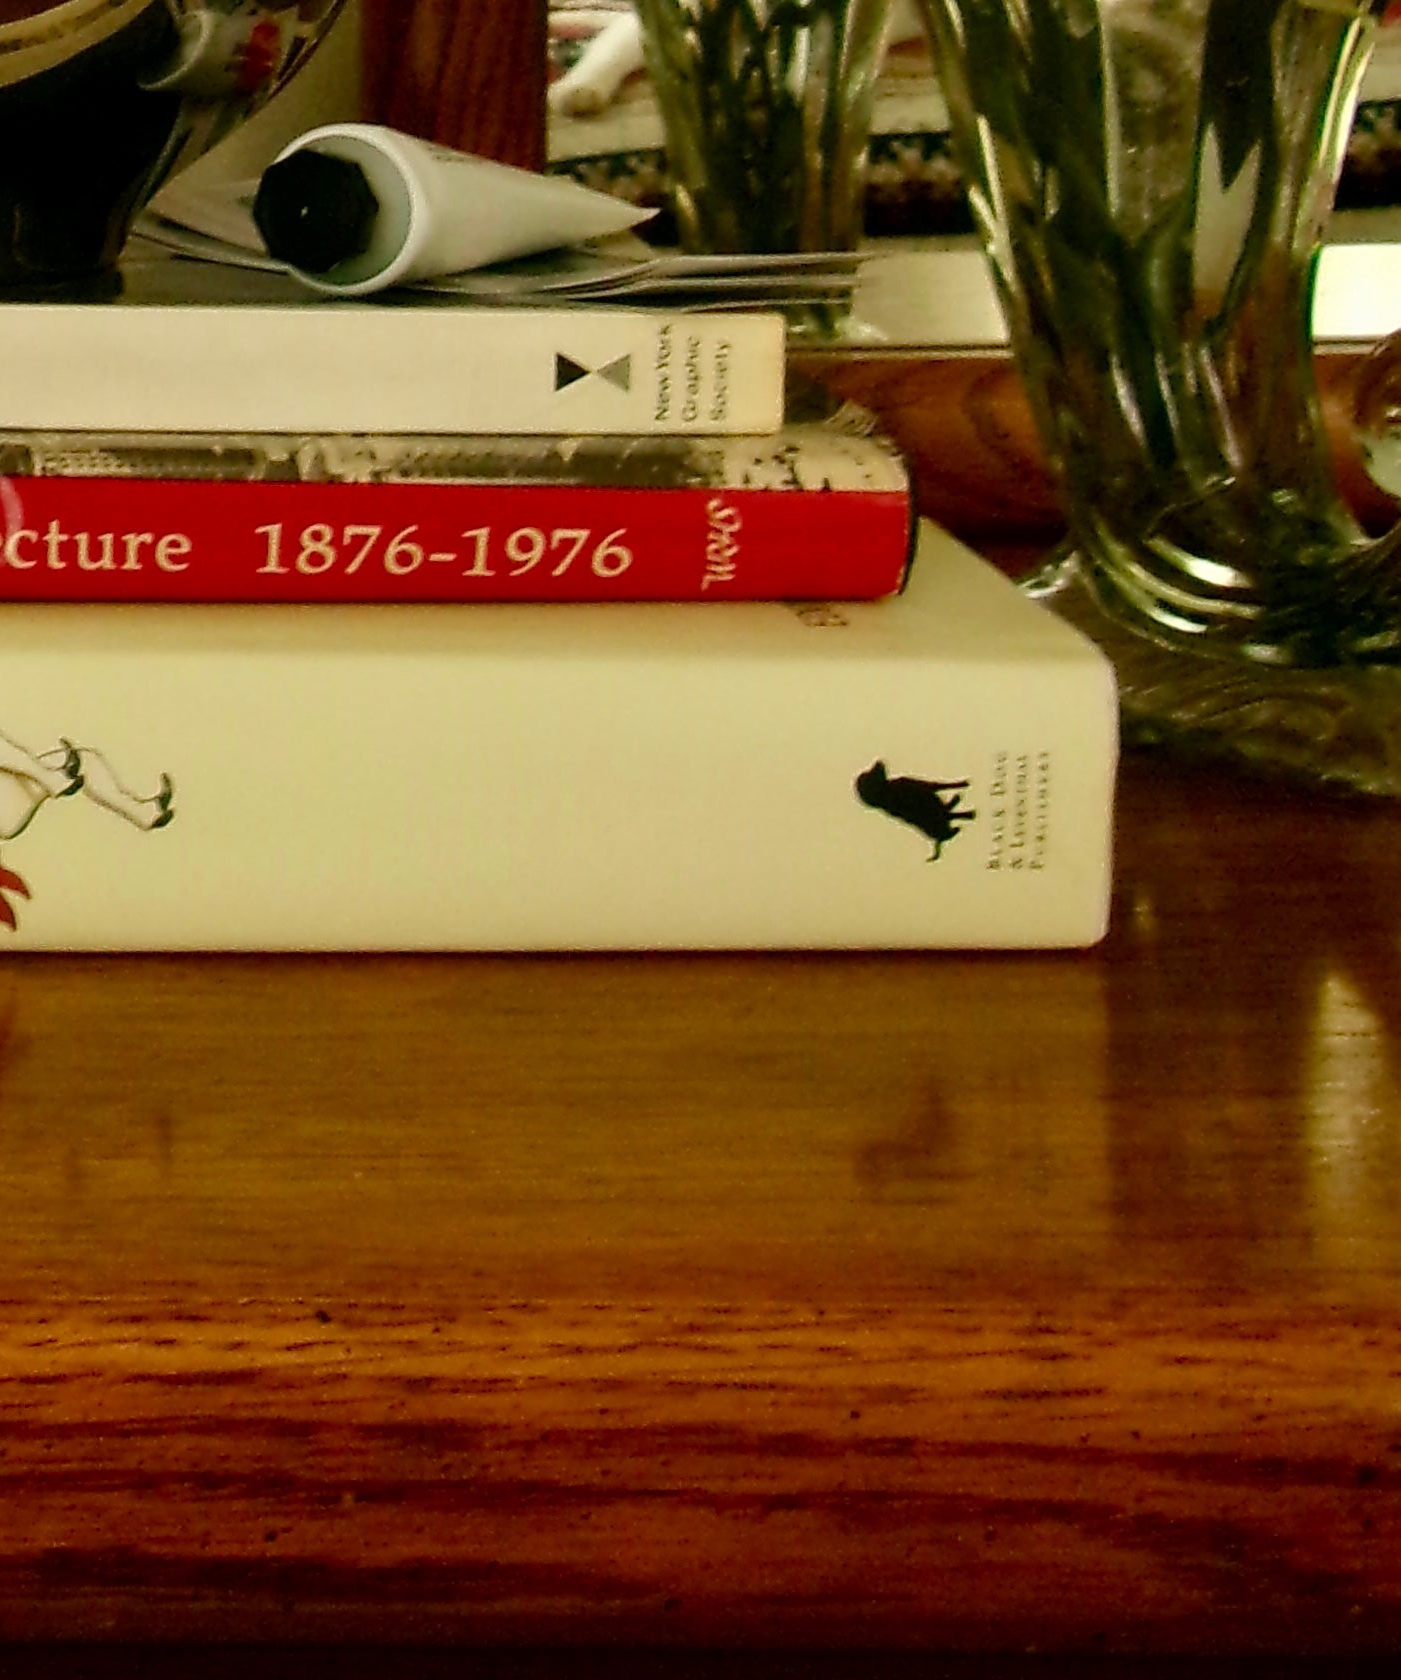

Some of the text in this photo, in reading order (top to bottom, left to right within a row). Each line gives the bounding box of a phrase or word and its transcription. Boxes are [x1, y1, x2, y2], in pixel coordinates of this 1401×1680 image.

[654, 323, 673, 421] New York
[681, 335, 701, 422] Graphic
[708, 342, 731, 422] Society
[253, 521, 634, 578] 1876-1976
